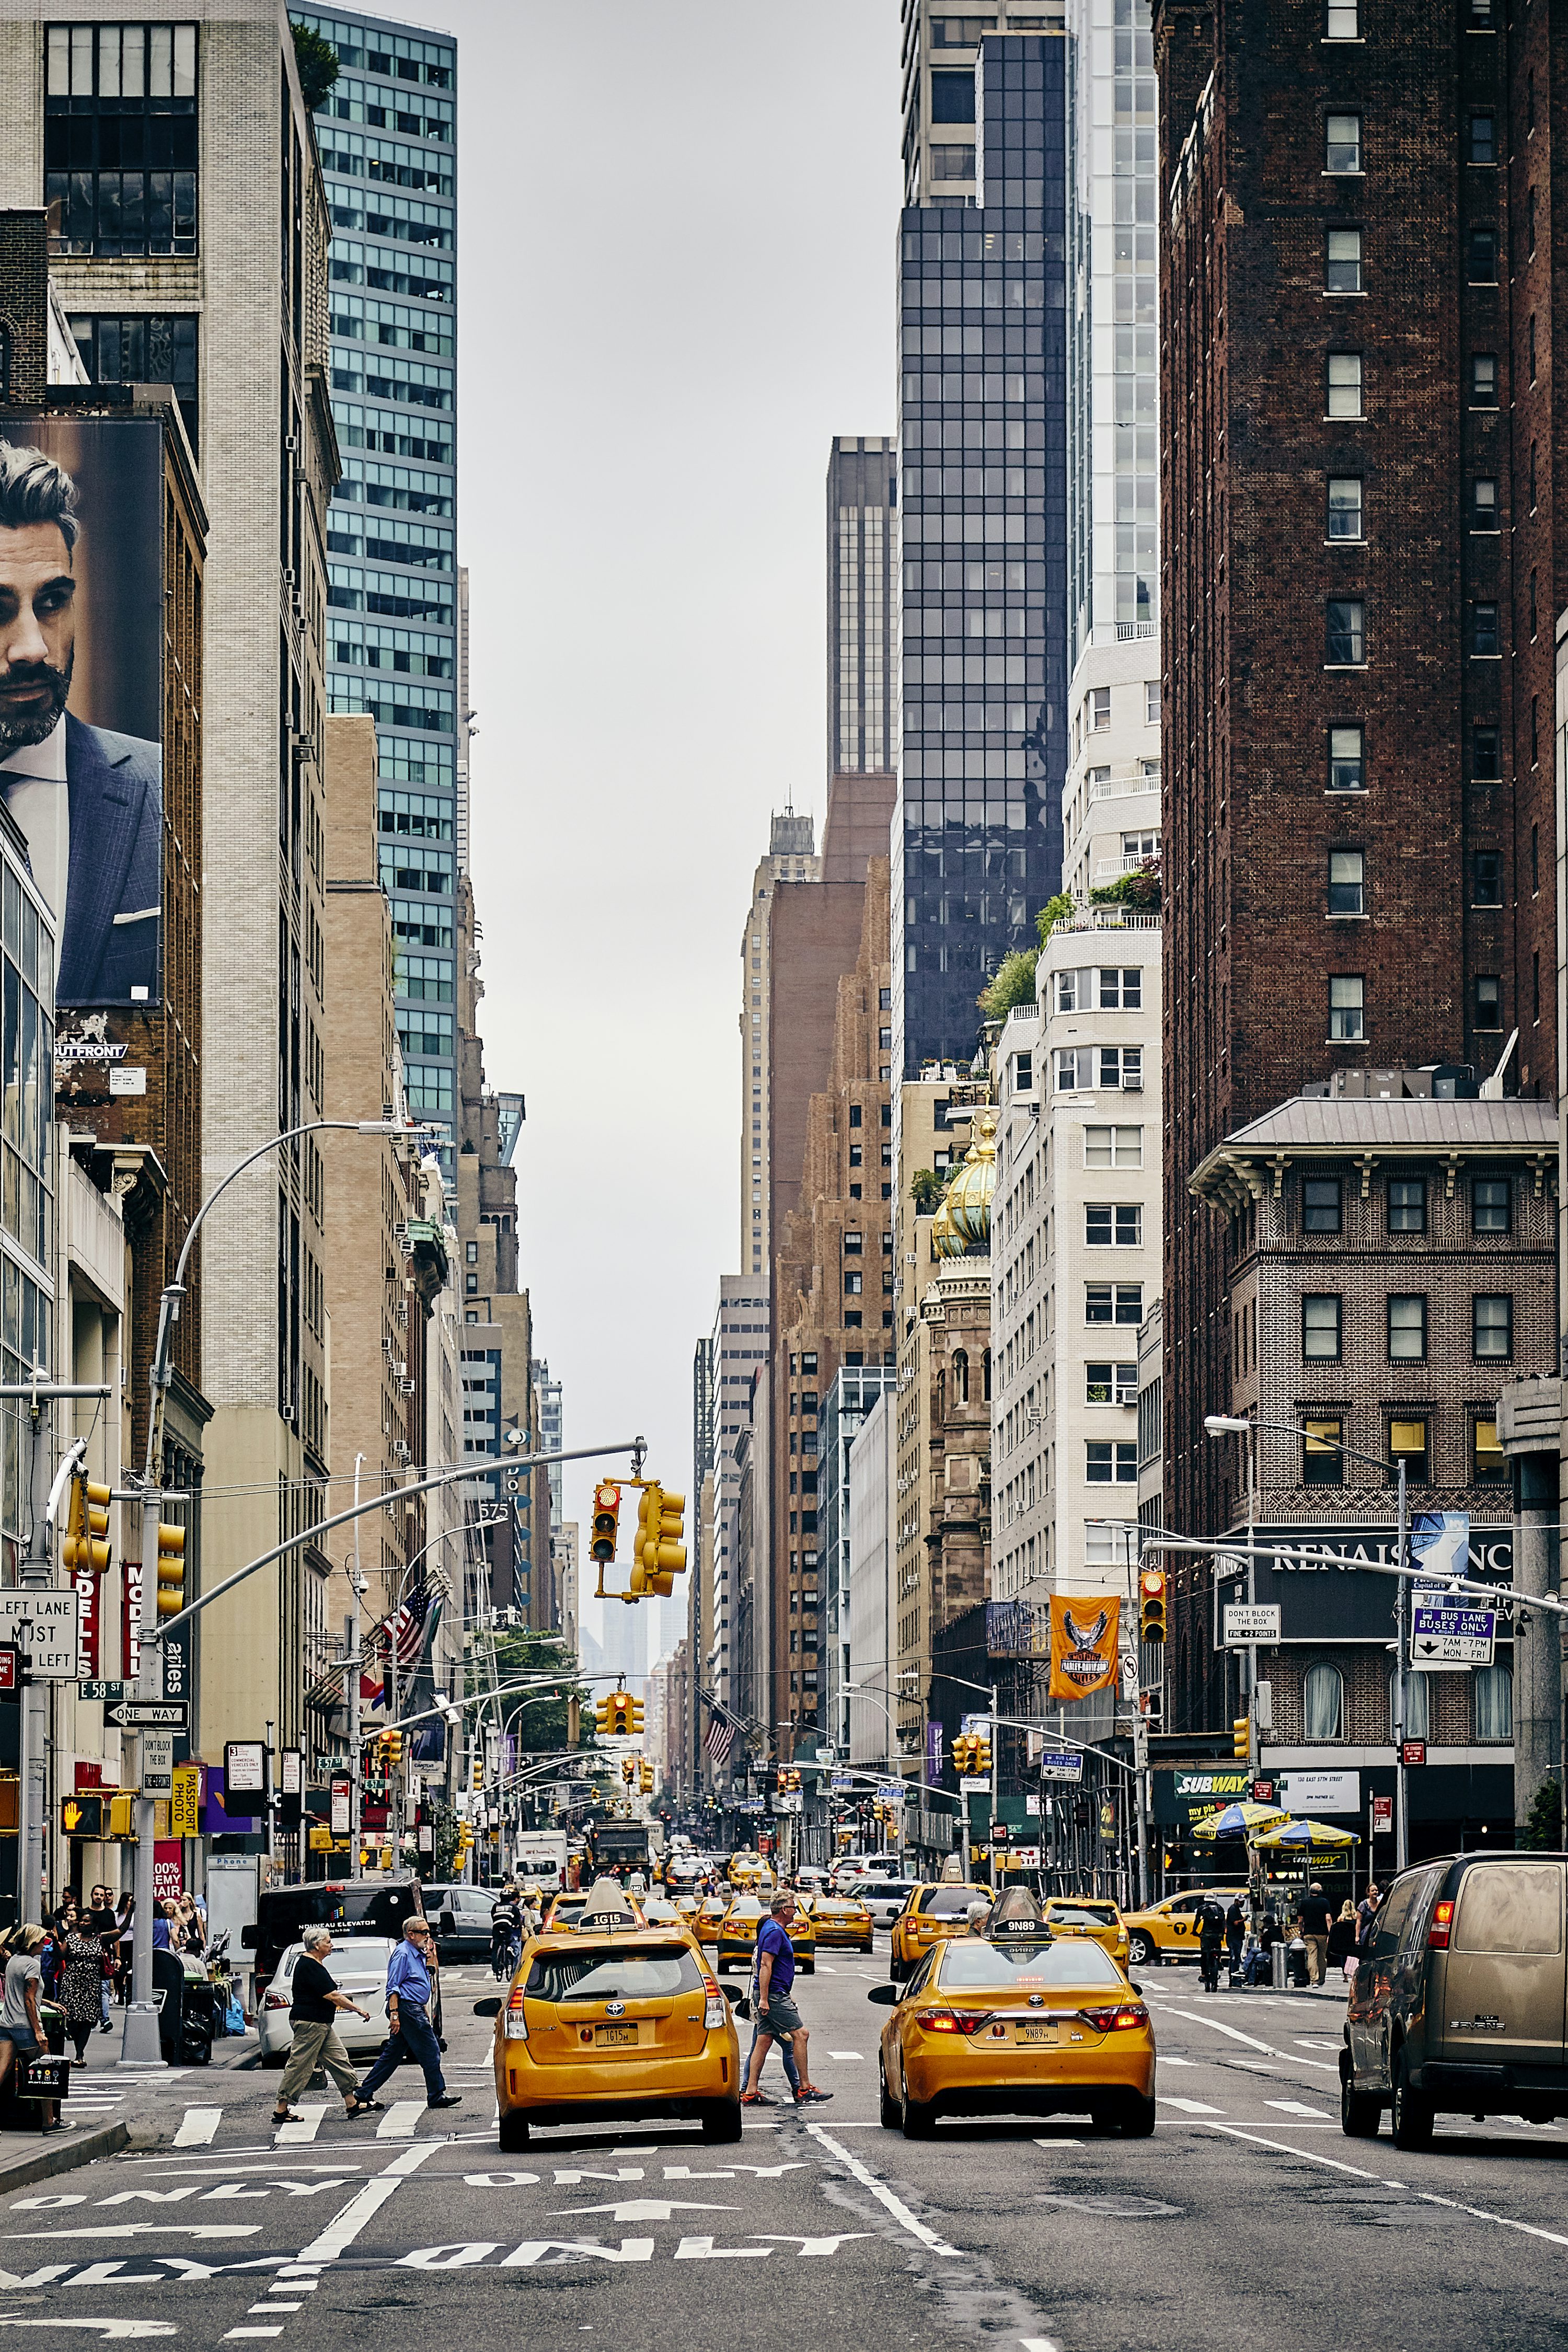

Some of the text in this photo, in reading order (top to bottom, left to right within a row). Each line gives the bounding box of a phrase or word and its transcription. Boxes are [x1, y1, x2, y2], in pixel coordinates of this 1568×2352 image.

[54, 1046, 123, 1057] UTFRONT
[481, 1504, 508, 1518] 575
[37, 1602, 71, 1615] LANE
[1440, 1611, 1486, 1623] BUS LANE
[128, 1567, 143, 1680] MODELL
[1419, 1620, 1488, 1632] BUSES ONLY
[1443, 1638, 1460, 1646] 7AM
[1468, 1639, 1486, 1648] 7PM
[1073, 1652, 1097, 1661] MOTOR
[1443, 1648, 1461, 1657] MON
[1471, 1650, 1485, 1658] FRI
[39, 1654, 70, 1667] LEFT
[1063, 1662, 1107, 1671] HARLEY-DAVIDSON
[1072, 1674, 1096, 1684] CYCLES
[81, 1682, 120, 1698] E 58 ST
[117, 1709, 177, 1720] ONE WAY
[145, 1740, 171, 1750] DON'T BLOCK
[231, 1747, 237, 1756] 3
[318, 1759, 322, 1768] E
[325, 1759, 333, 1768] 57
[371, 1780, 378, 1788] 57
[1177, 1776, 1249, 1794] SUBWAY
[175, 1783, 184, 1821] PHOTO
[186, 1774, 195, 1830] PASSPORT
[1189, 1807, 1202, 1816] my
[153, 1862, 179, 1874] 00%
[593, 1914, 621, 1924] 1G15
[1008, 1921, 1035, 1931] 9N89
[1450, 2021, 1505, 2030] SAVANA
[463, 2163, 811, 2187] ONLY
[9, 2178, 356, 2209] ONLY
[391, 2233, 877, 2269] ONLY
